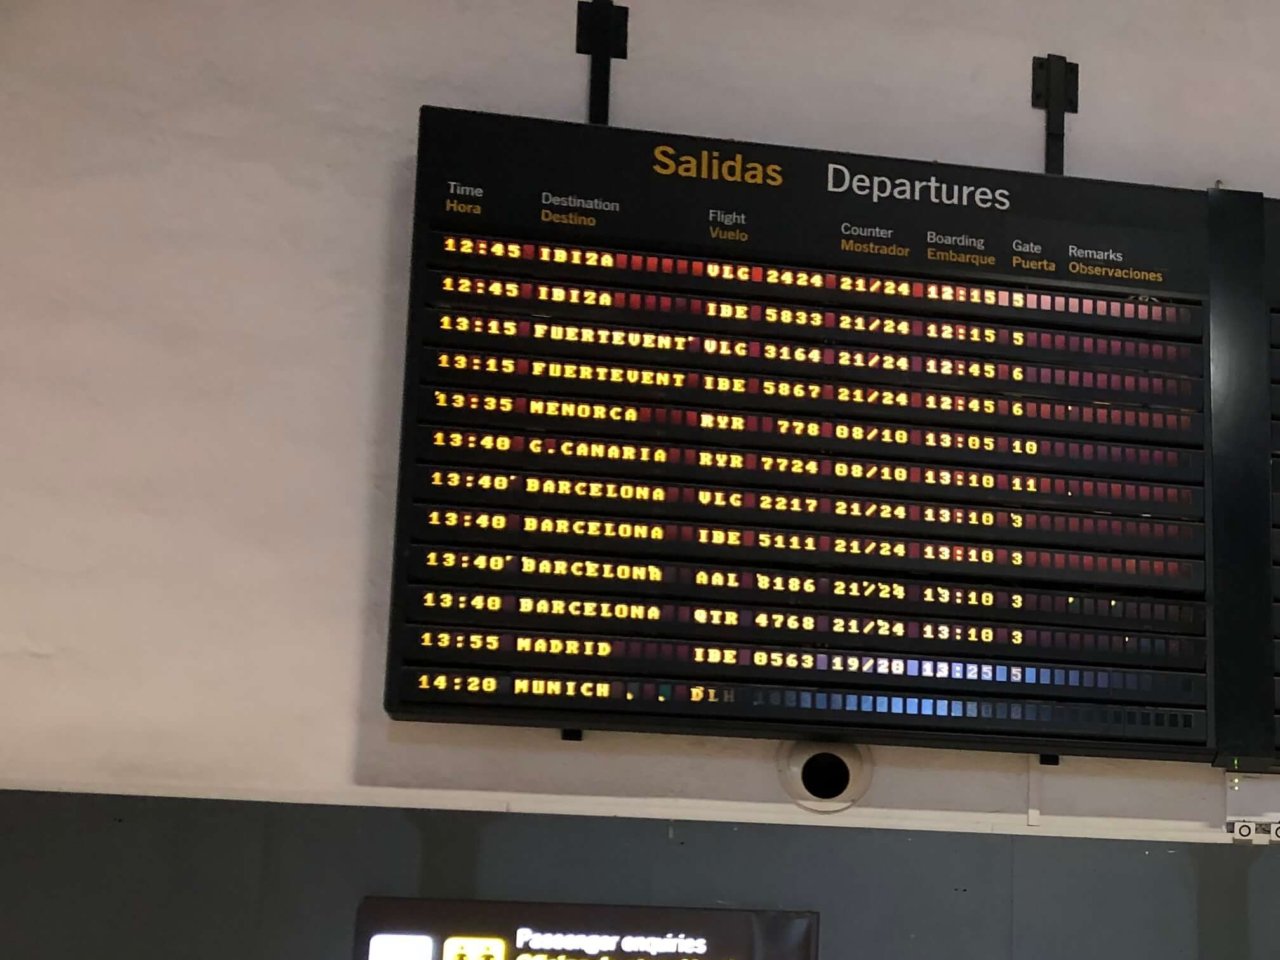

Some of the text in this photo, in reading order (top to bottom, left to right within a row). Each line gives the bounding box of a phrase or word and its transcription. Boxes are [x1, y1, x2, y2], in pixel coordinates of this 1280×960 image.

[653, 146, 1011, 211] Salidas Departures
[447, 181, 1124, 263] Time Destination Flight Counter Boarding Gate Remarks
[445, 199, 1164, 283] Hora Destino Vuelo Mostrador Embarque Puerta Observaciones
[445, 238, 521, 258] 12:45
[442, 277, 519, 297] 12:45
[707, 302, 748, 319] IBE
[765, 308, 823, 326] 5833
[839, 315, 910, 335] 21/24
[926, 323, 996, 343] 12:15
[1012, 331, 1024, 346] 5
[440, 315, 1024, 381] 13:15 FUERTEVENT VLG 3164 21/24 12:45 6
[438, 354, 685, 387] 13:15 FUERTEVENT
[434, 390, 638, 422] 13:35 MENORCA
[433, 432, 667, 463] 13:40 G.CANARIA
[431, 471, 665, 501] 13:40 BARCELONA
[429, 511, 994, 563] 13:40 BARCELONA IBE 5111 21/24 13:10
[426, 553, 662, 581] 13:40 BARCELONA
[423, 592, 661, 620] 13:40 BARCELONA
[421, 632, 612, 656] 13:55 MADRID
[419, 674, 610, 698] 14:20 MUNICH
[516, 928, 620, 955] Passenger
